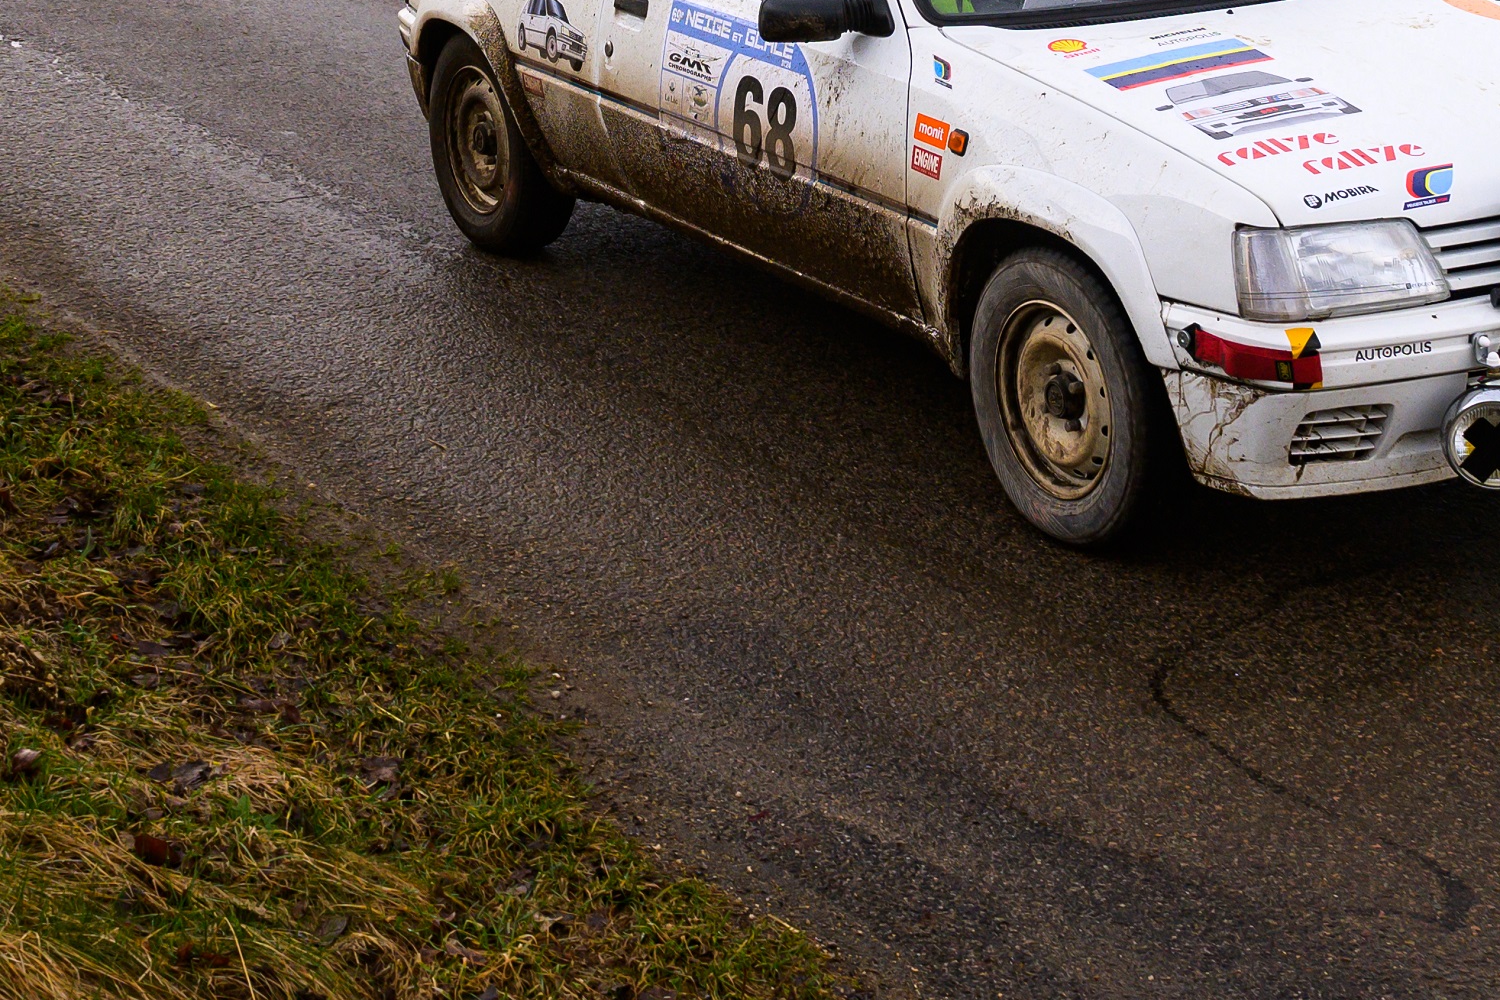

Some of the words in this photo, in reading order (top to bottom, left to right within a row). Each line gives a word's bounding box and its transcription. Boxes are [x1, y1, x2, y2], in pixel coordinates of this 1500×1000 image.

[685, 9, 732, 40] NEIGE
[1150, 27, 1206, 40] MICHELIN
[1157, 31, 1222, 47] AUTOPOLIS
[669, 52, 712, 75] GMT
[1063, 47, 1101, 60] Shell
[733, 75, 797, 181] 68
[918, 121, 945, 141] monit
[1217, 132, 1339, 167] rallye
[1302, 143, 1426, 175] rallye
[913, 148, 940, 174] ENGINE
[1324, 184, 1380, 204] MOBIRA
[1355, 341, 1433, 362] AUTOPOLIS
